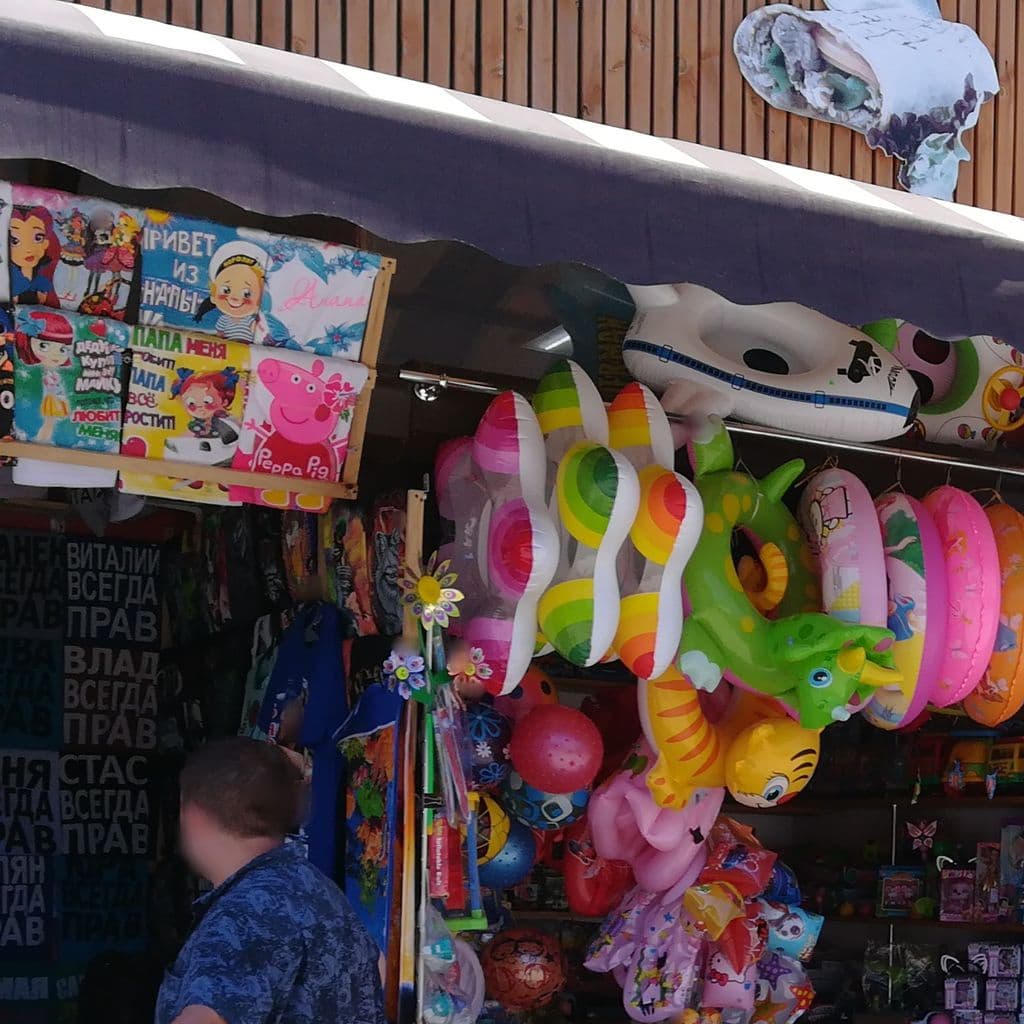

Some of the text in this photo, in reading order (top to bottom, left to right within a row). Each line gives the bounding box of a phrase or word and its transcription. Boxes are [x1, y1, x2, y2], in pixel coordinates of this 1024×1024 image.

[173, 259, 198, 284] ИЗ
[141, 280, 199, 314] НАПЫ
[132, 326, 228, 359] ПАПА МЕНЯ
[258, 448, 330, 480] Peppa Pig
[66, 542, 161, 574] ВИТАЛИЙ
[0, 566, 65, 596] ЕГДА
[67, 572, 159, 607] ВСЕГДА
[67, 606, 158, 642] ПРАВ
[64, 645, 160, 683] ВЛАД
[64, 678, 159, 717] ВСЕГДА
[64, 713, 157, 750] ПРАВ
[60, 754, 149, 786] СТАС
[0, 787, 53, 822] ГДА
[60, 789, 149, 823] ВСЕГДА
[61, 824, 150, 855] ПРАВ
[0, 916, 45, 948] АВ
